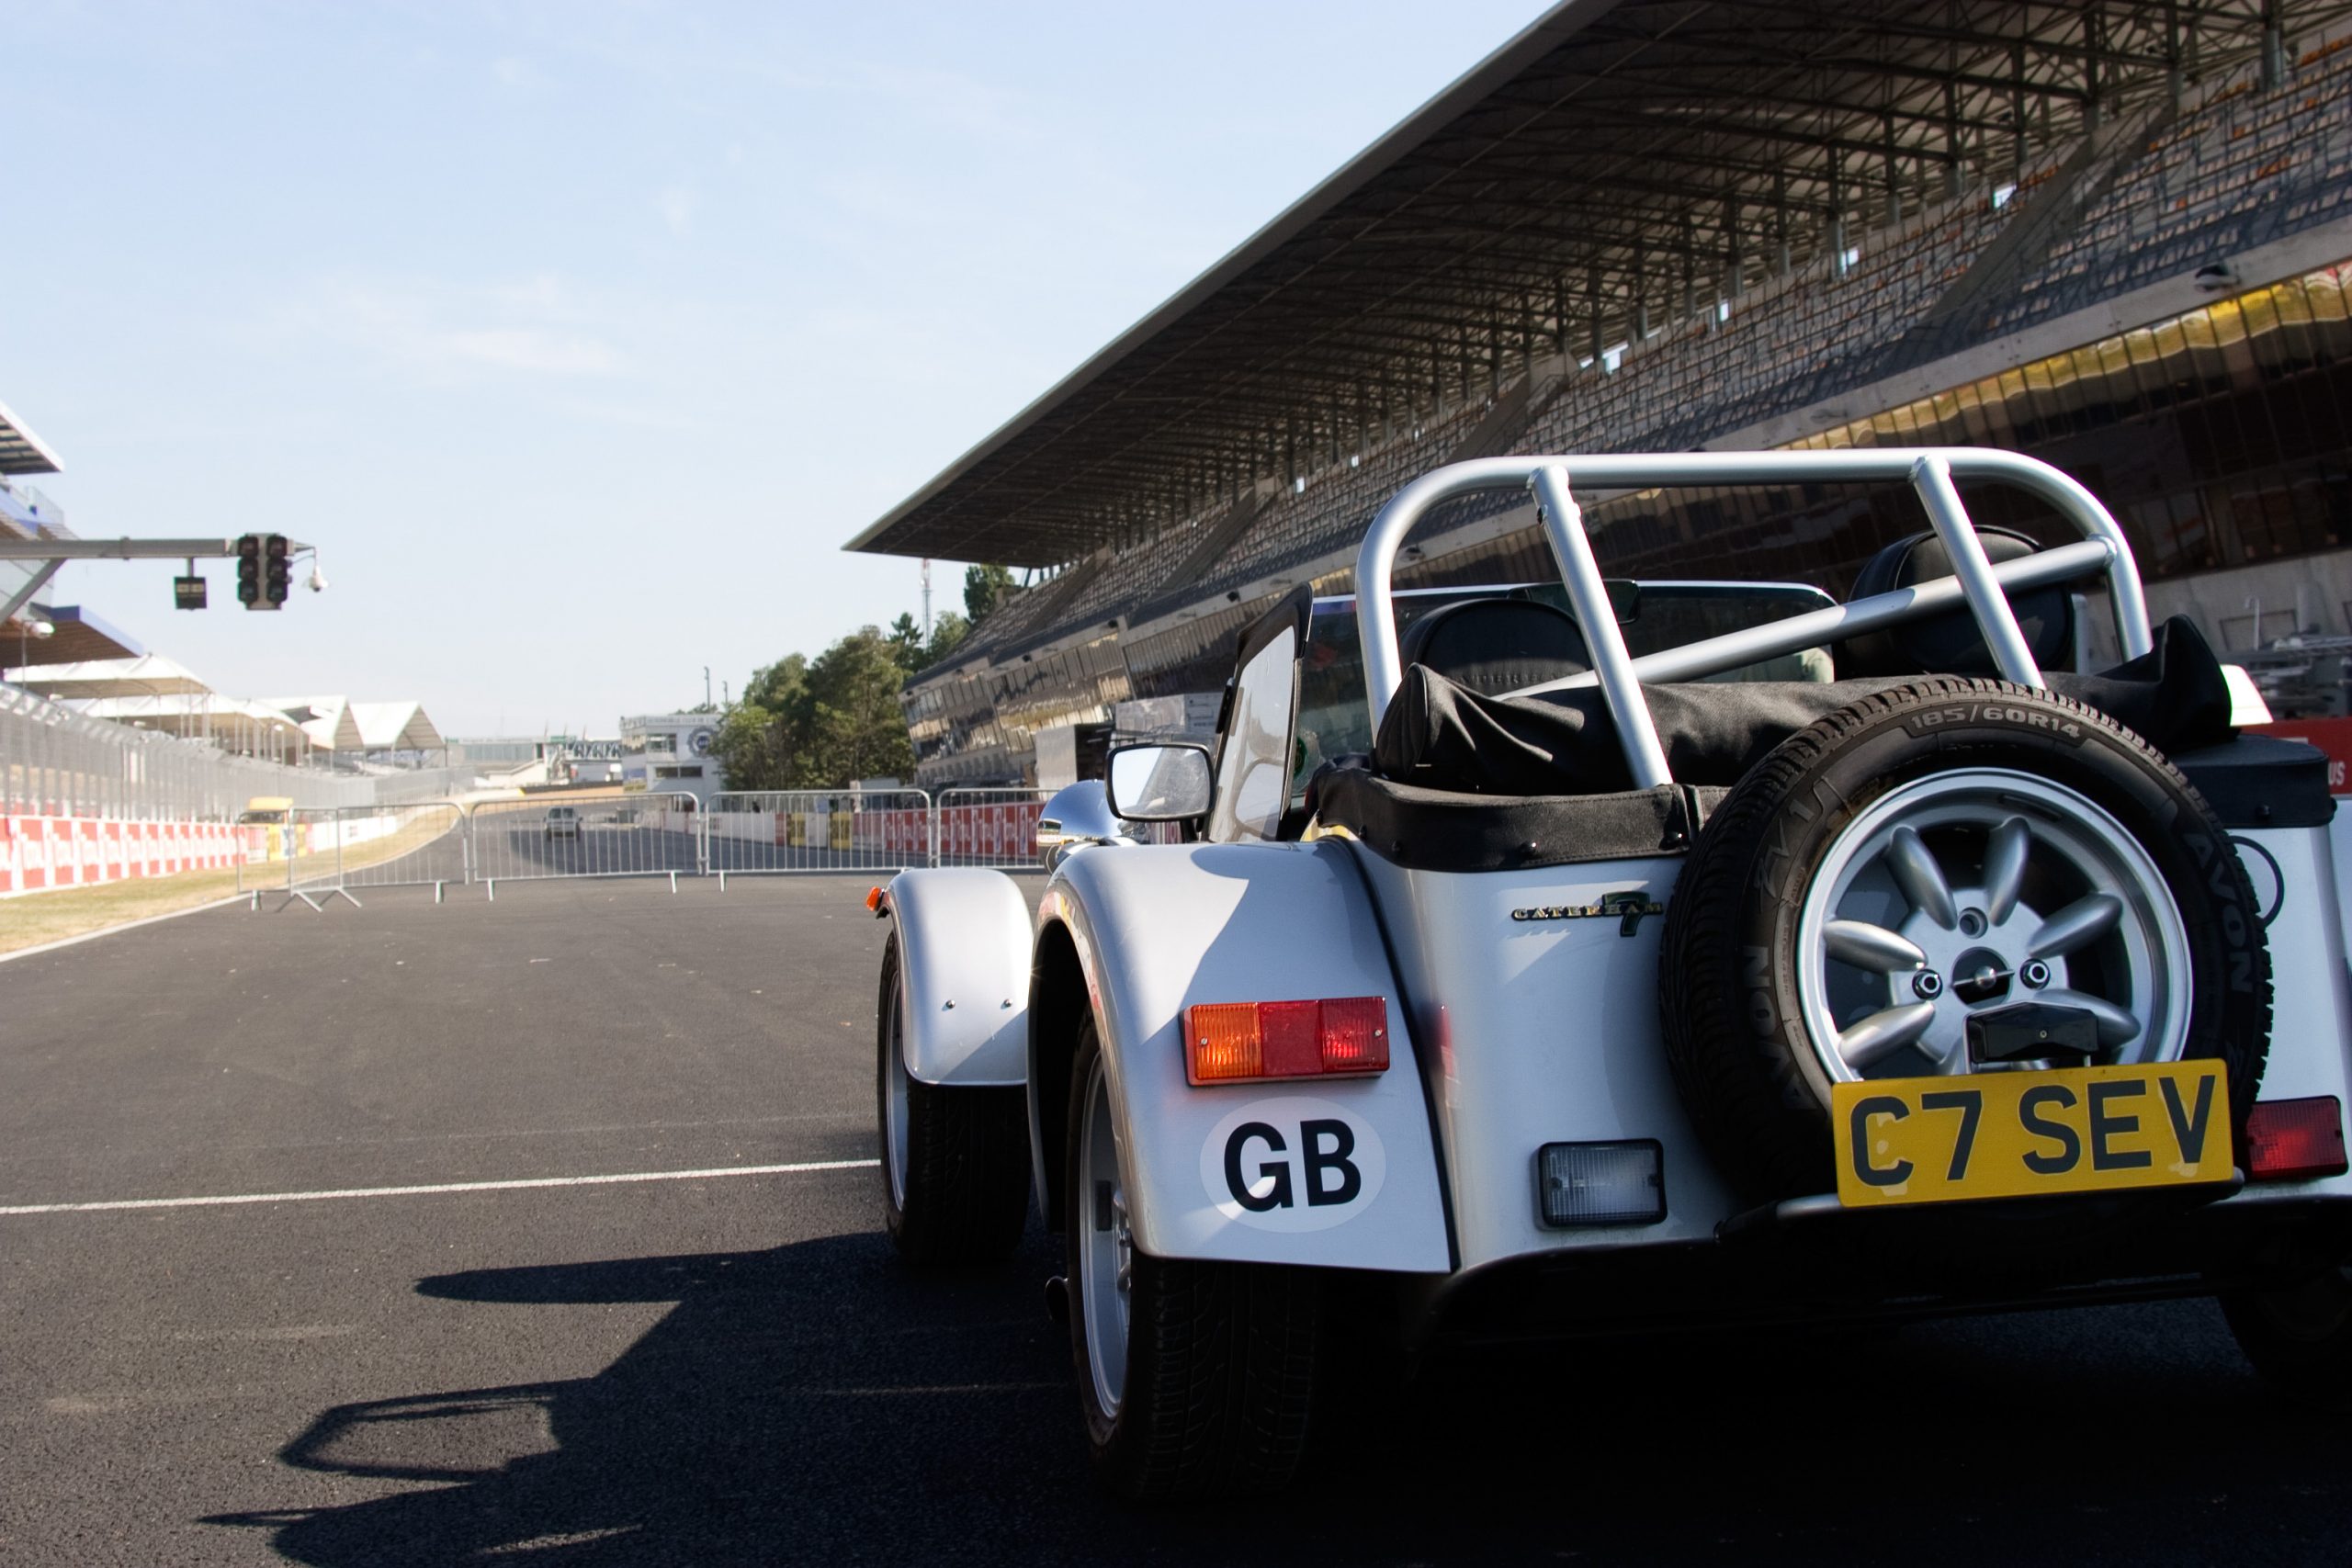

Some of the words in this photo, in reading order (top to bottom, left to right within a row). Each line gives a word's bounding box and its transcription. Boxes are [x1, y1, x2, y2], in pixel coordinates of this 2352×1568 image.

[1910, 705, 2080, 739] 185/60R14
[1512, 902, 1664, 920] CATERHAM
[2182, 832, 2254, 994] AVON
[1223, 1118, 1362, 1213] GB
[1849, 1089, 1982, 1187] C7
[2019, 1074, 2217, 1174] SEV
